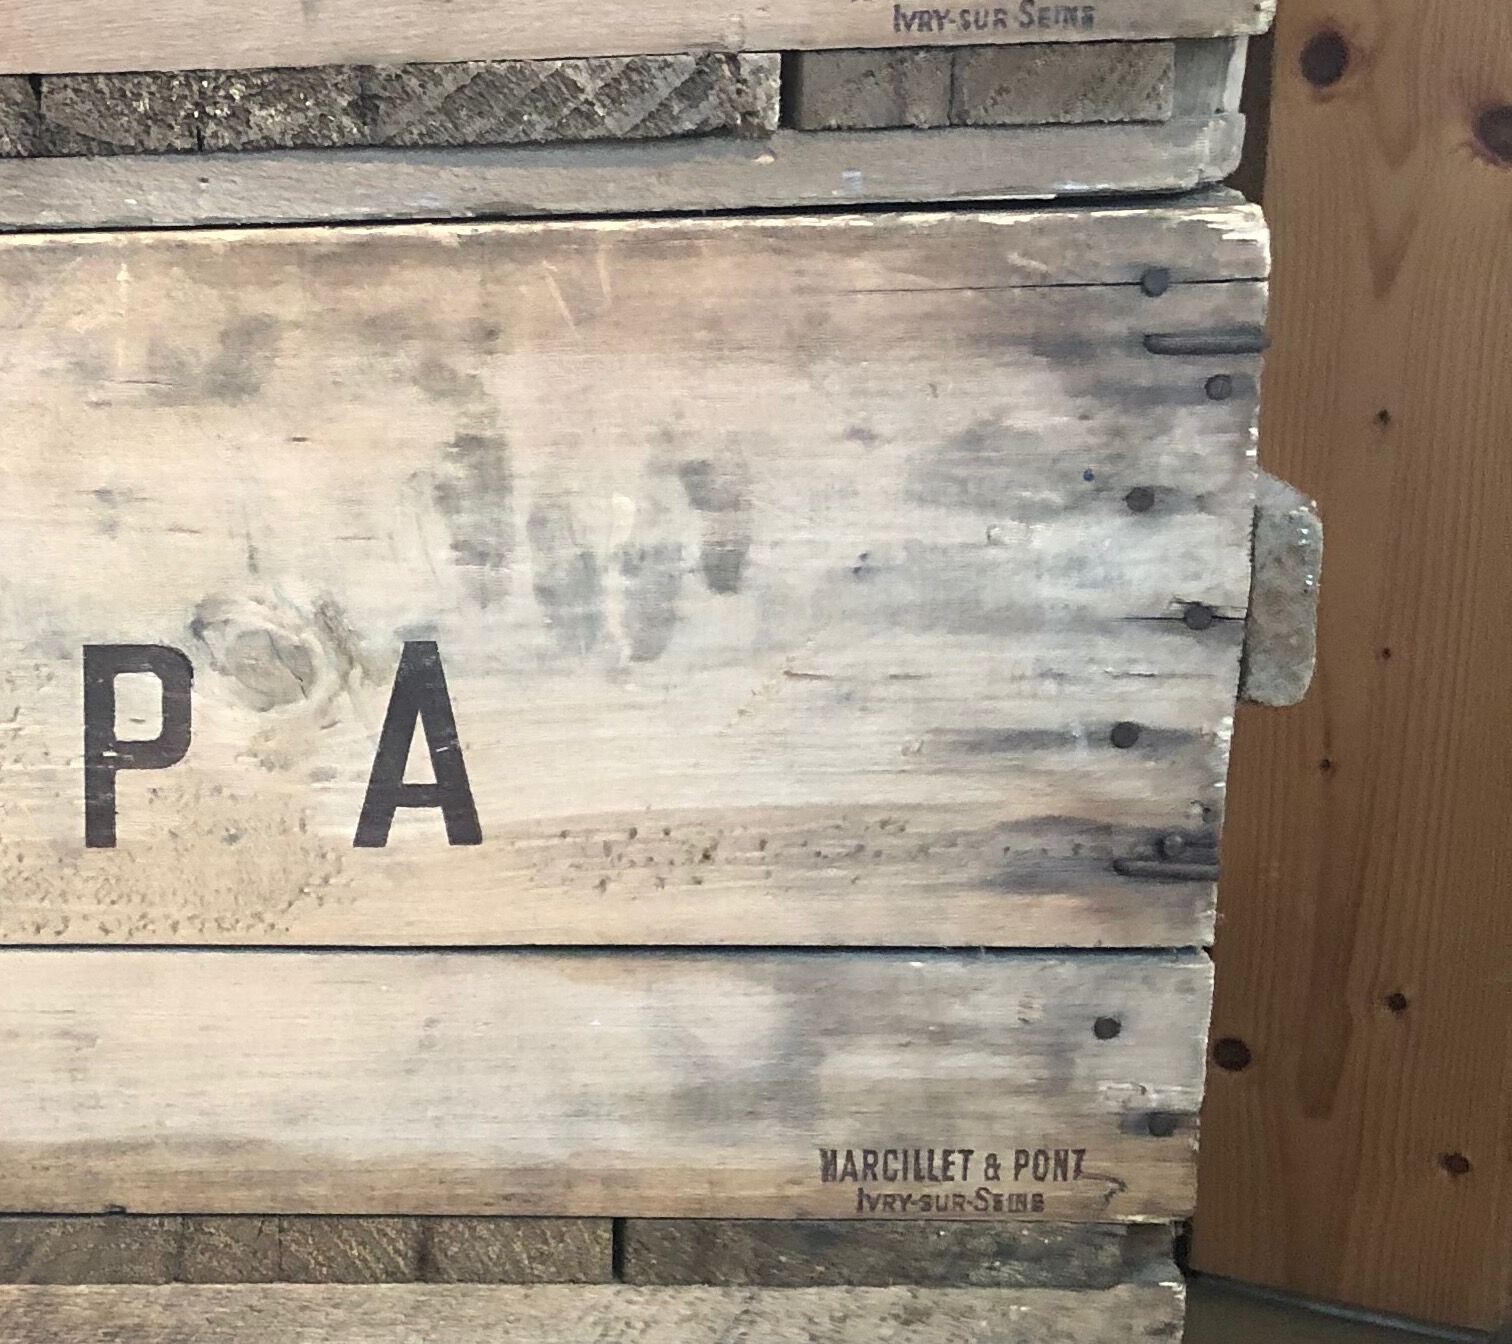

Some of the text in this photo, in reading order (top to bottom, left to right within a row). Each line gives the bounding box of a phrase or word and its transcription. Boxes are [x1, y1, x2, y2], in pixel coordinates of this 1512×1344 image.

[818, 1147, 1087, 1183] MARCILLET & PONT
